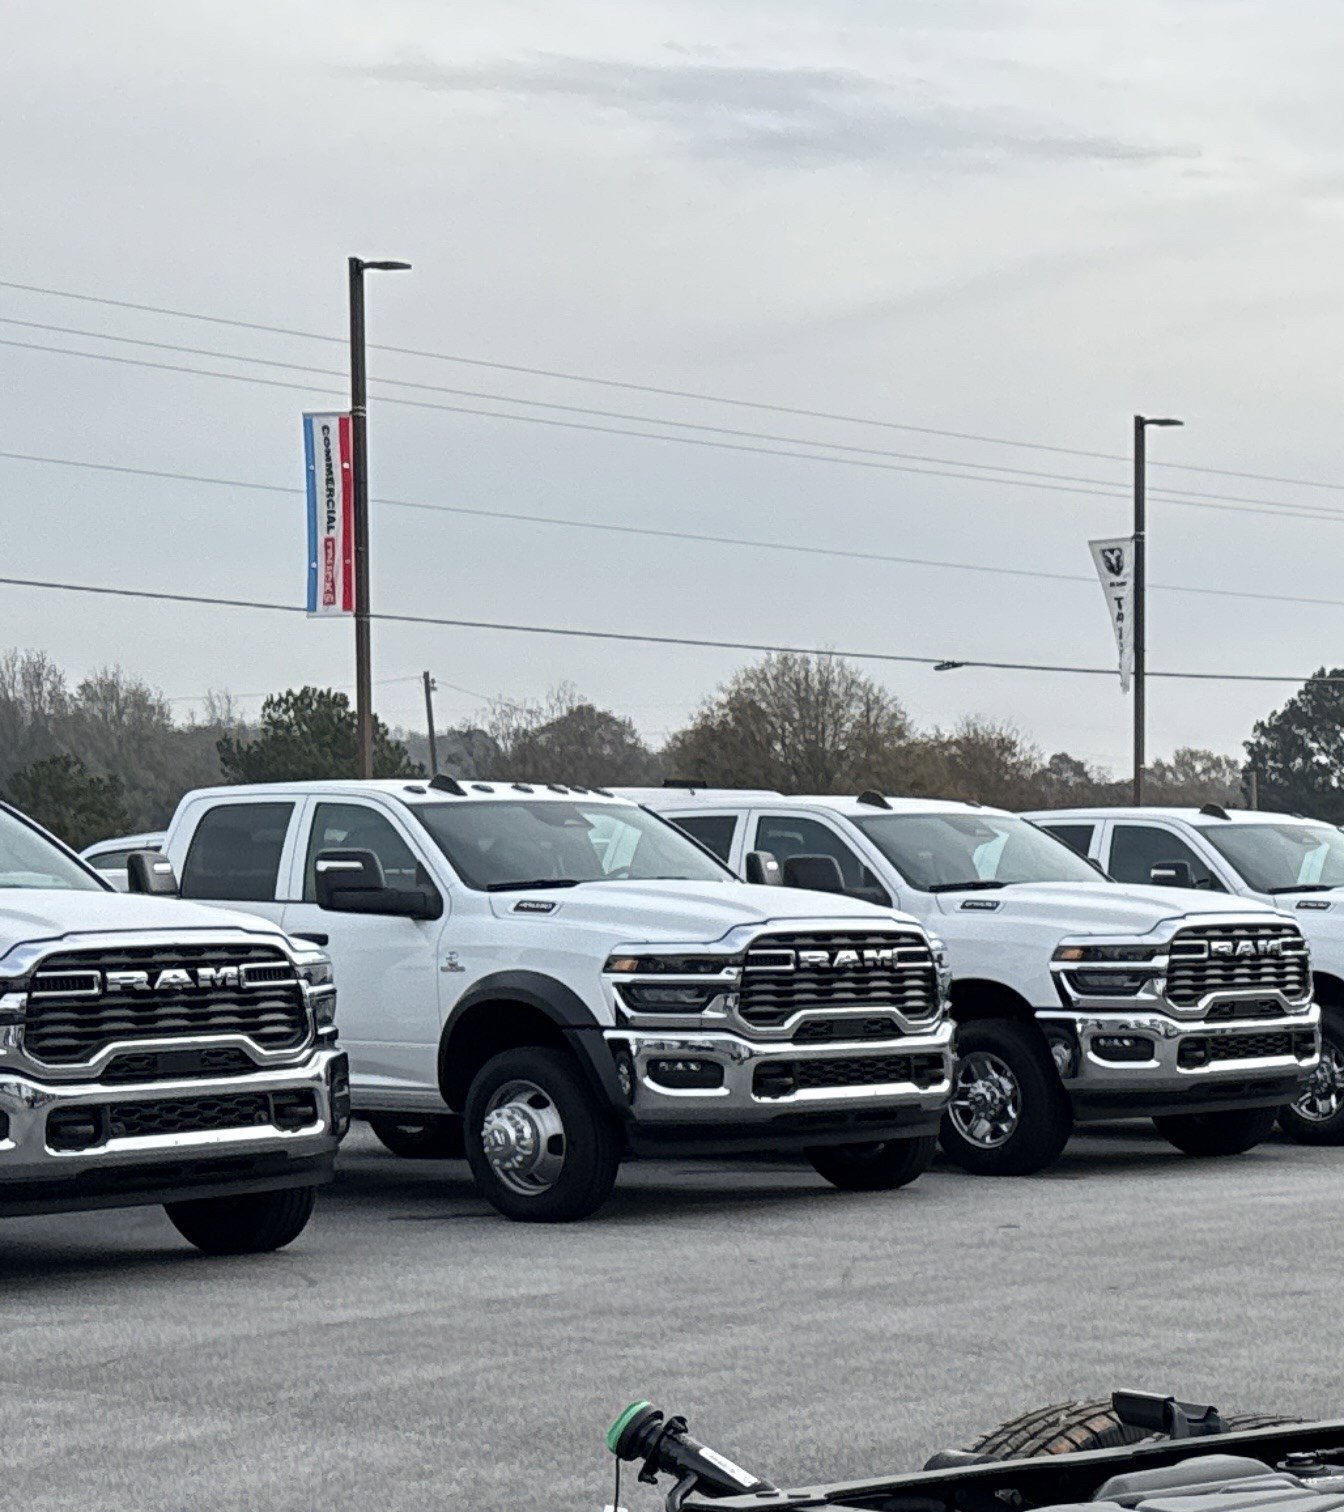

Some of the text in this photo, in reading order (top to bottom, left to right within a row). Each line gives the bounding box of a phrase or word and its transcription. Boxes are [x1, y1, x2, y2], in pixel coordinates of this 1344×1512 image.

[321, 424, 336, 534] COMMERCIAL
[799, 949, 893, 969] RAM
[1210, 939, 1281, 957] RAM
[106, 966, 239, 992] RAM
